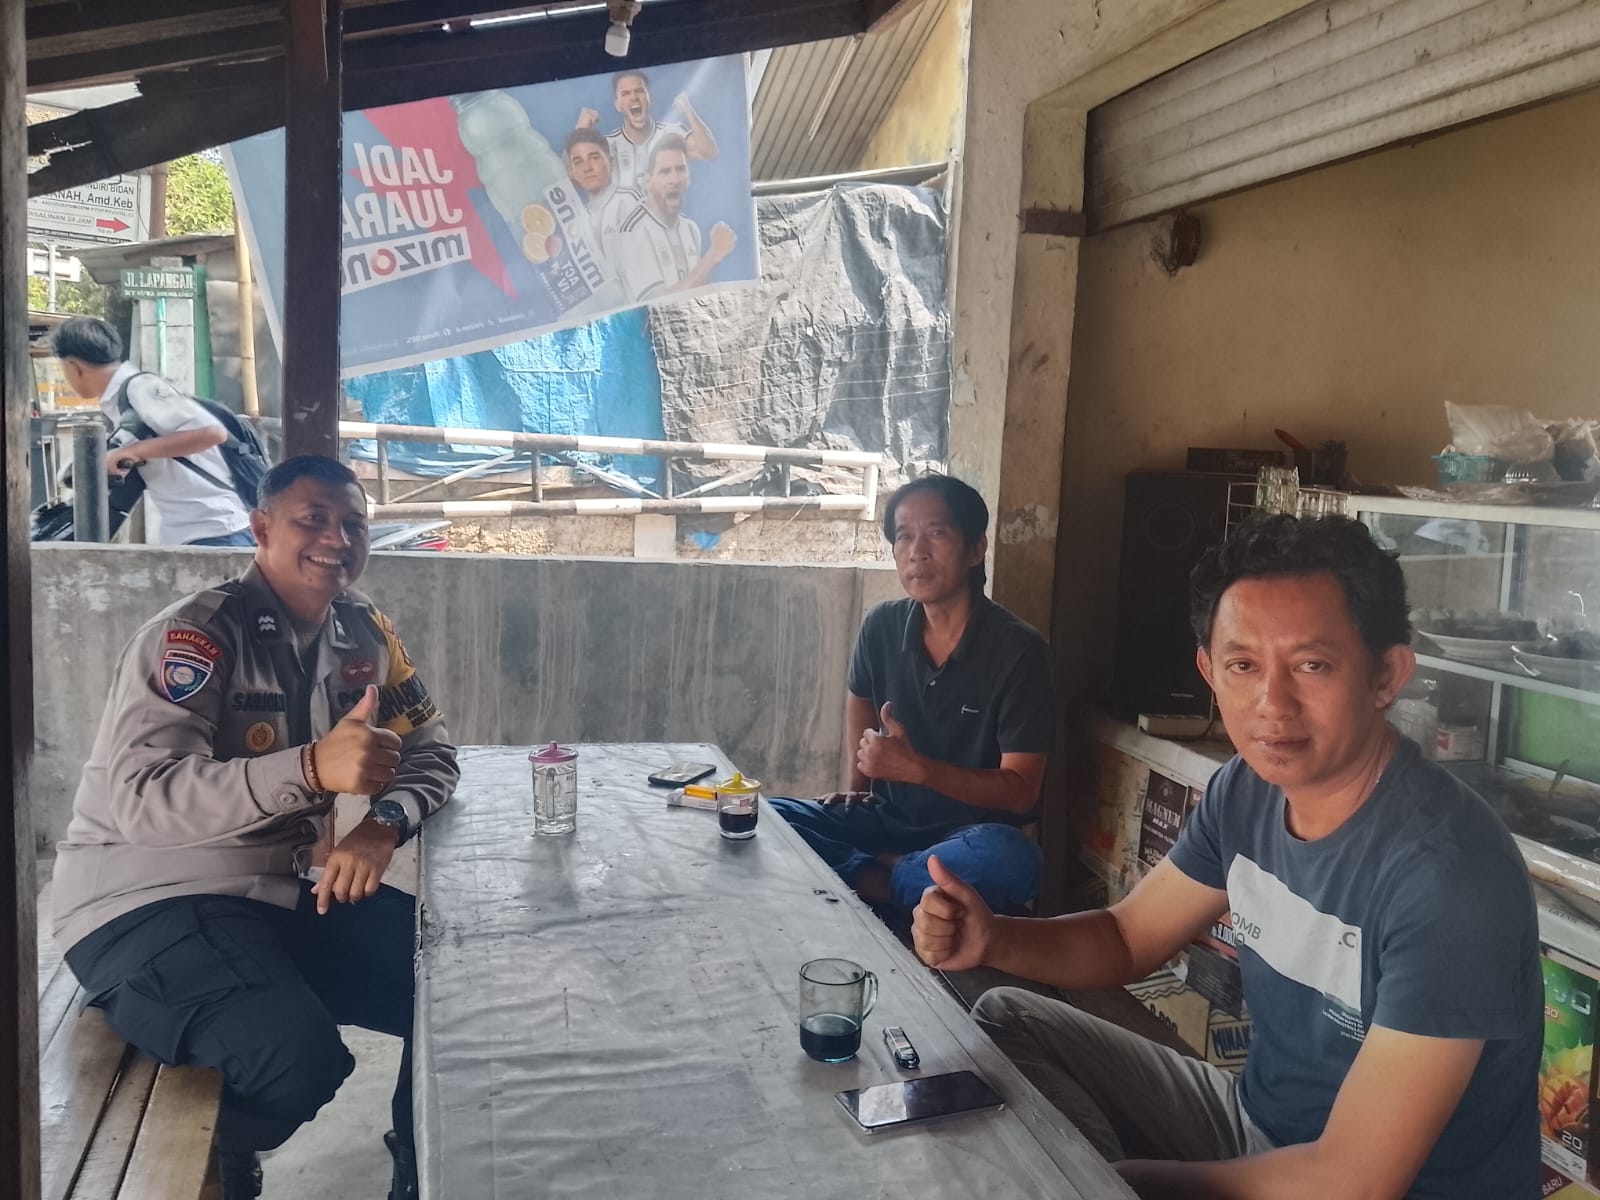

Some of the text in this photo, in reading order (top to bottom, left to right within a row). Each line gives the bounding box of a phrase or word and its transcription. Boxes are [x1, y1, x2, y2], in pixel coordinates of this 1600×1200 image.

[110, 185, 134, 195] BIDAN
[87, 193, 133, 208] Amd.Keb
[140, 272, 193, 289] LAPANGAN
[1145, 798, 1181, 828] MAGNUM
[1231, 912, 1262, 940] OMB
[1562, 1130, 1582, 1150] 20
